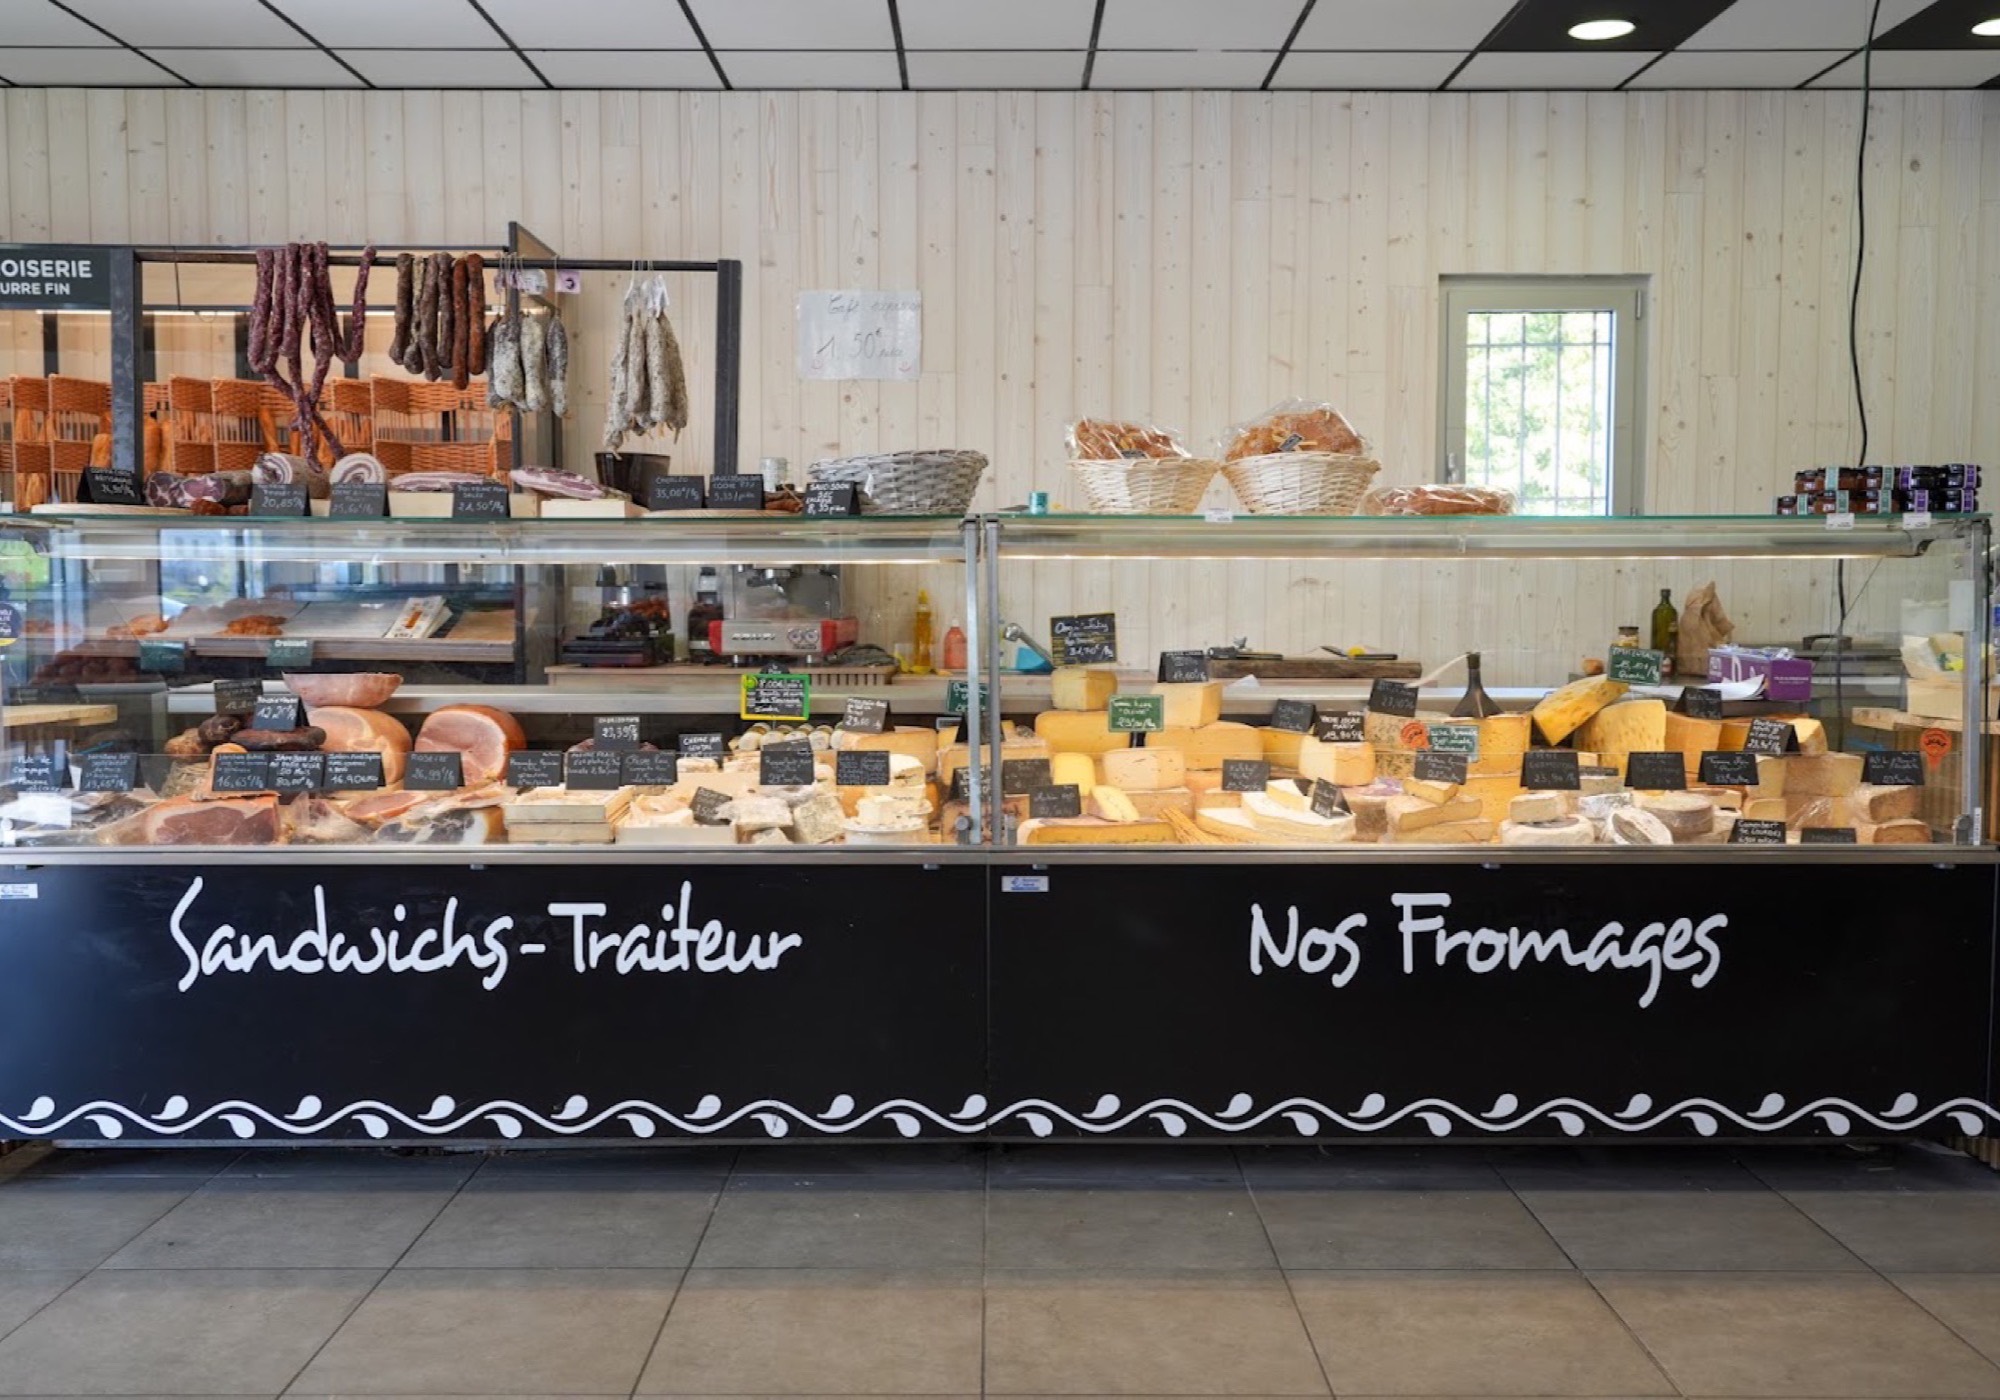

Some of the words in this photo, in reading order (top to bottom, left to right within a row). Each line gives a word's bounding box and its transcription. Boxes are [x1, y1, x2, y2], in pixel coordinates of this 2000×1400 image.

[44, 282, 71, 295] FIN
[1250, 903, 1367, 988] Nos
[1391, 892, 1728, 1008] Fromages
